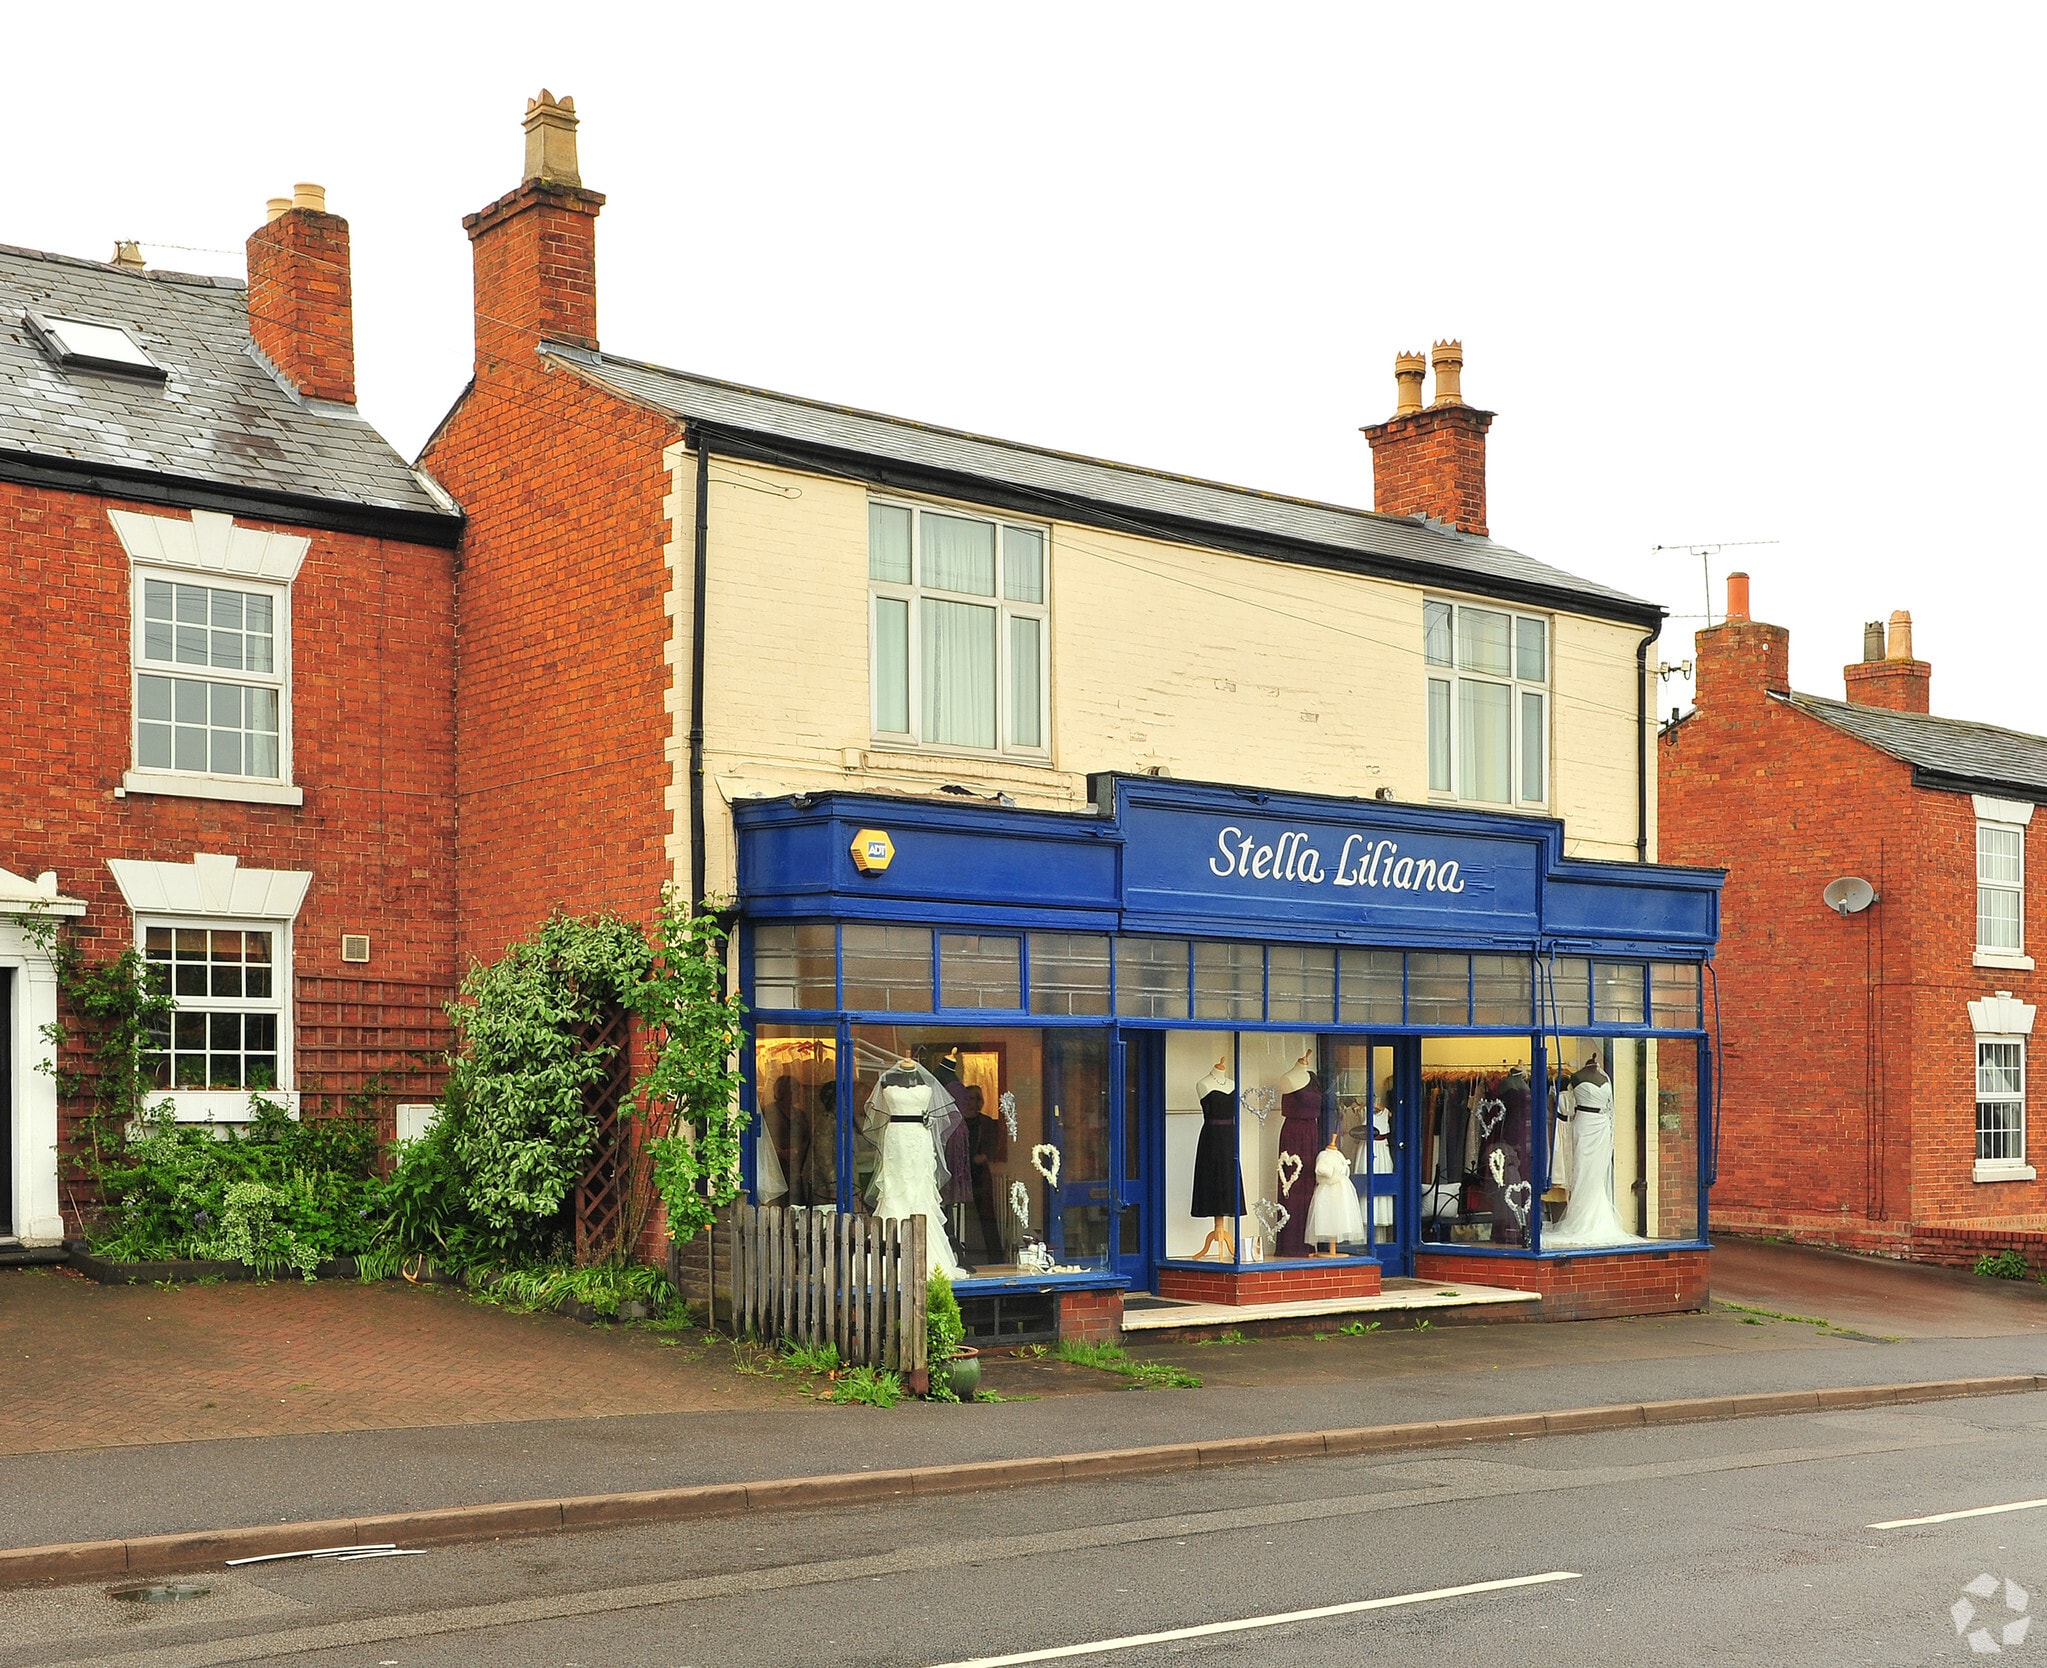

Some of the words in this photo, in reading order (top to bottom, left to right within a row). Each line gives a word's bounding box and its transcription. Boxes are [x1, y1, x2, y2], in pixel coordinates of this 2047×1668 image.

[868, 843, 886, 857] ADT
[1209, 826, 1326, 884] Stella
[1332, 833, 1465, 893] Liliana
